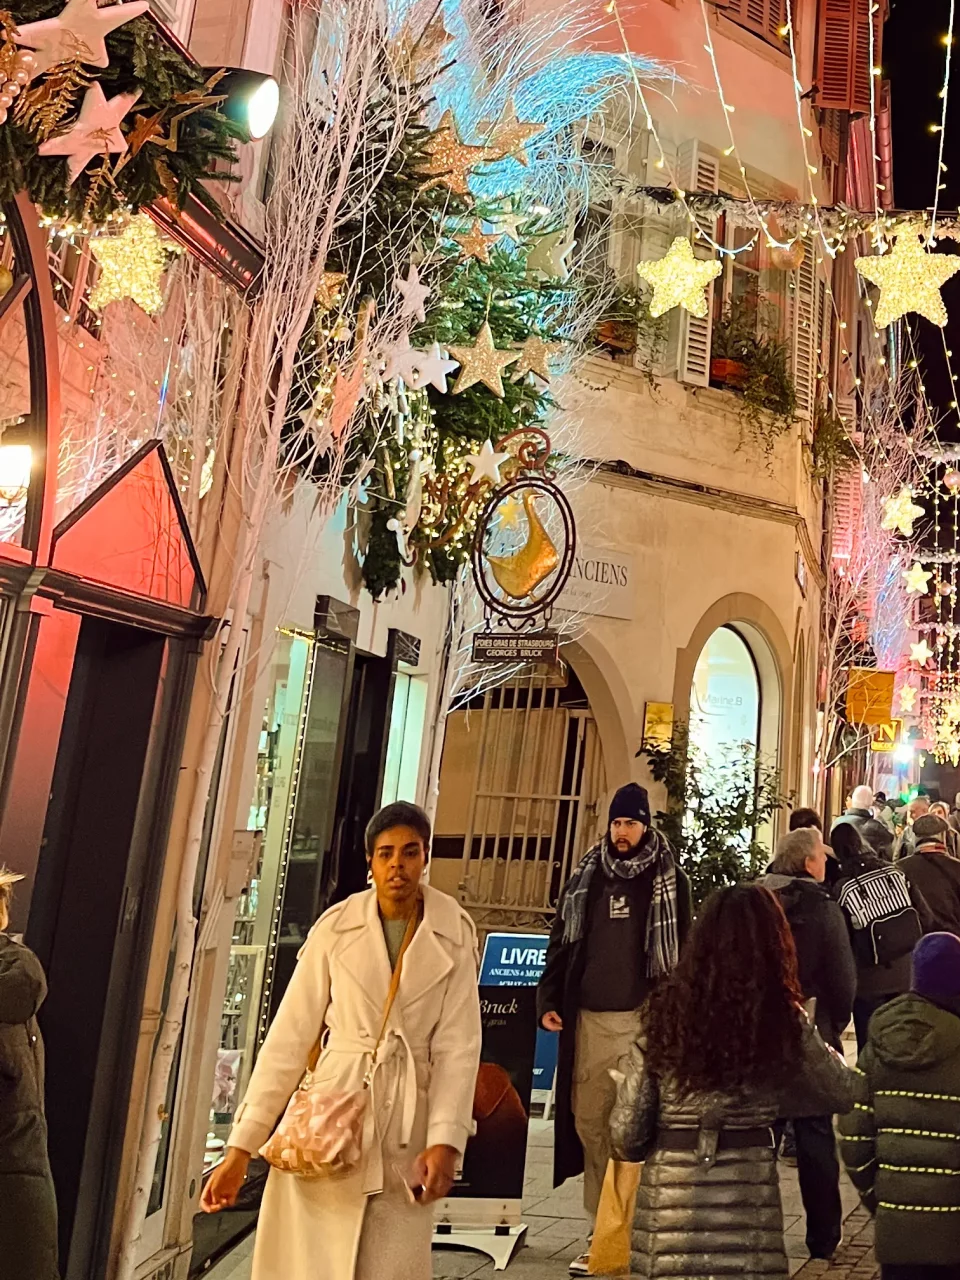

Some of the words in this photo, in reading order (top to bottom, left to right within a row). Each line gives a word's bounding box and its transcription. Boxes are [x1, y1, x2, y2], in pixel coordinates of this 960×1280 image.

[566, 556, 628, 587] NCIENS
[493, 639, 508, 647] GRAS
[517, 639, 554, 648] STRASBOURG
[486, 649, 517, 657] GEORGES
[520, 649, 543, 657] BRUCK
[878, 721, 898, 742] N
[488, 968, 520, 977] ANCIENS
[480, 998, 518, 1014] Bruck
